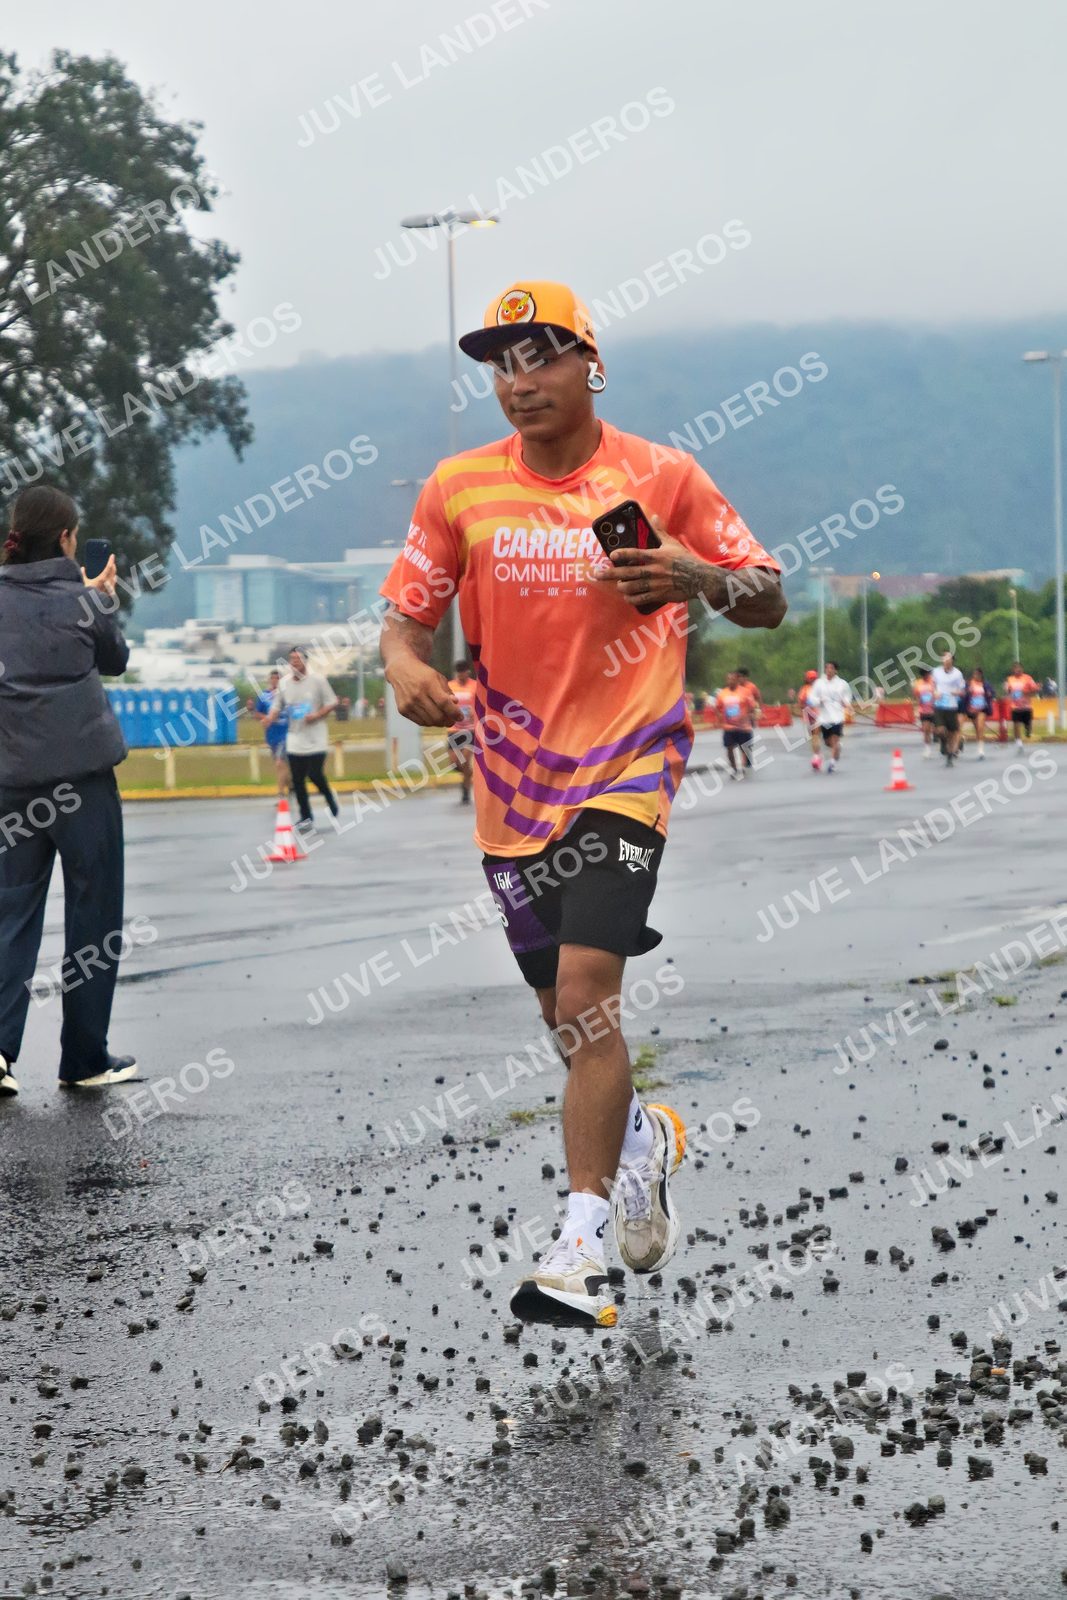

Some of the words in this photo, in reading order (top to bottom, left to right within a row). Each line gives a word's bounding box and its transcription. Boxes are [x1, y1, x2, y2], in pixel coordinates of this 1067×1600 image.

[493, 526, 606, 559] CARRER
[494, 562, 585, 582] OMNILIFE
[493, 871, 513, 890] 15K
